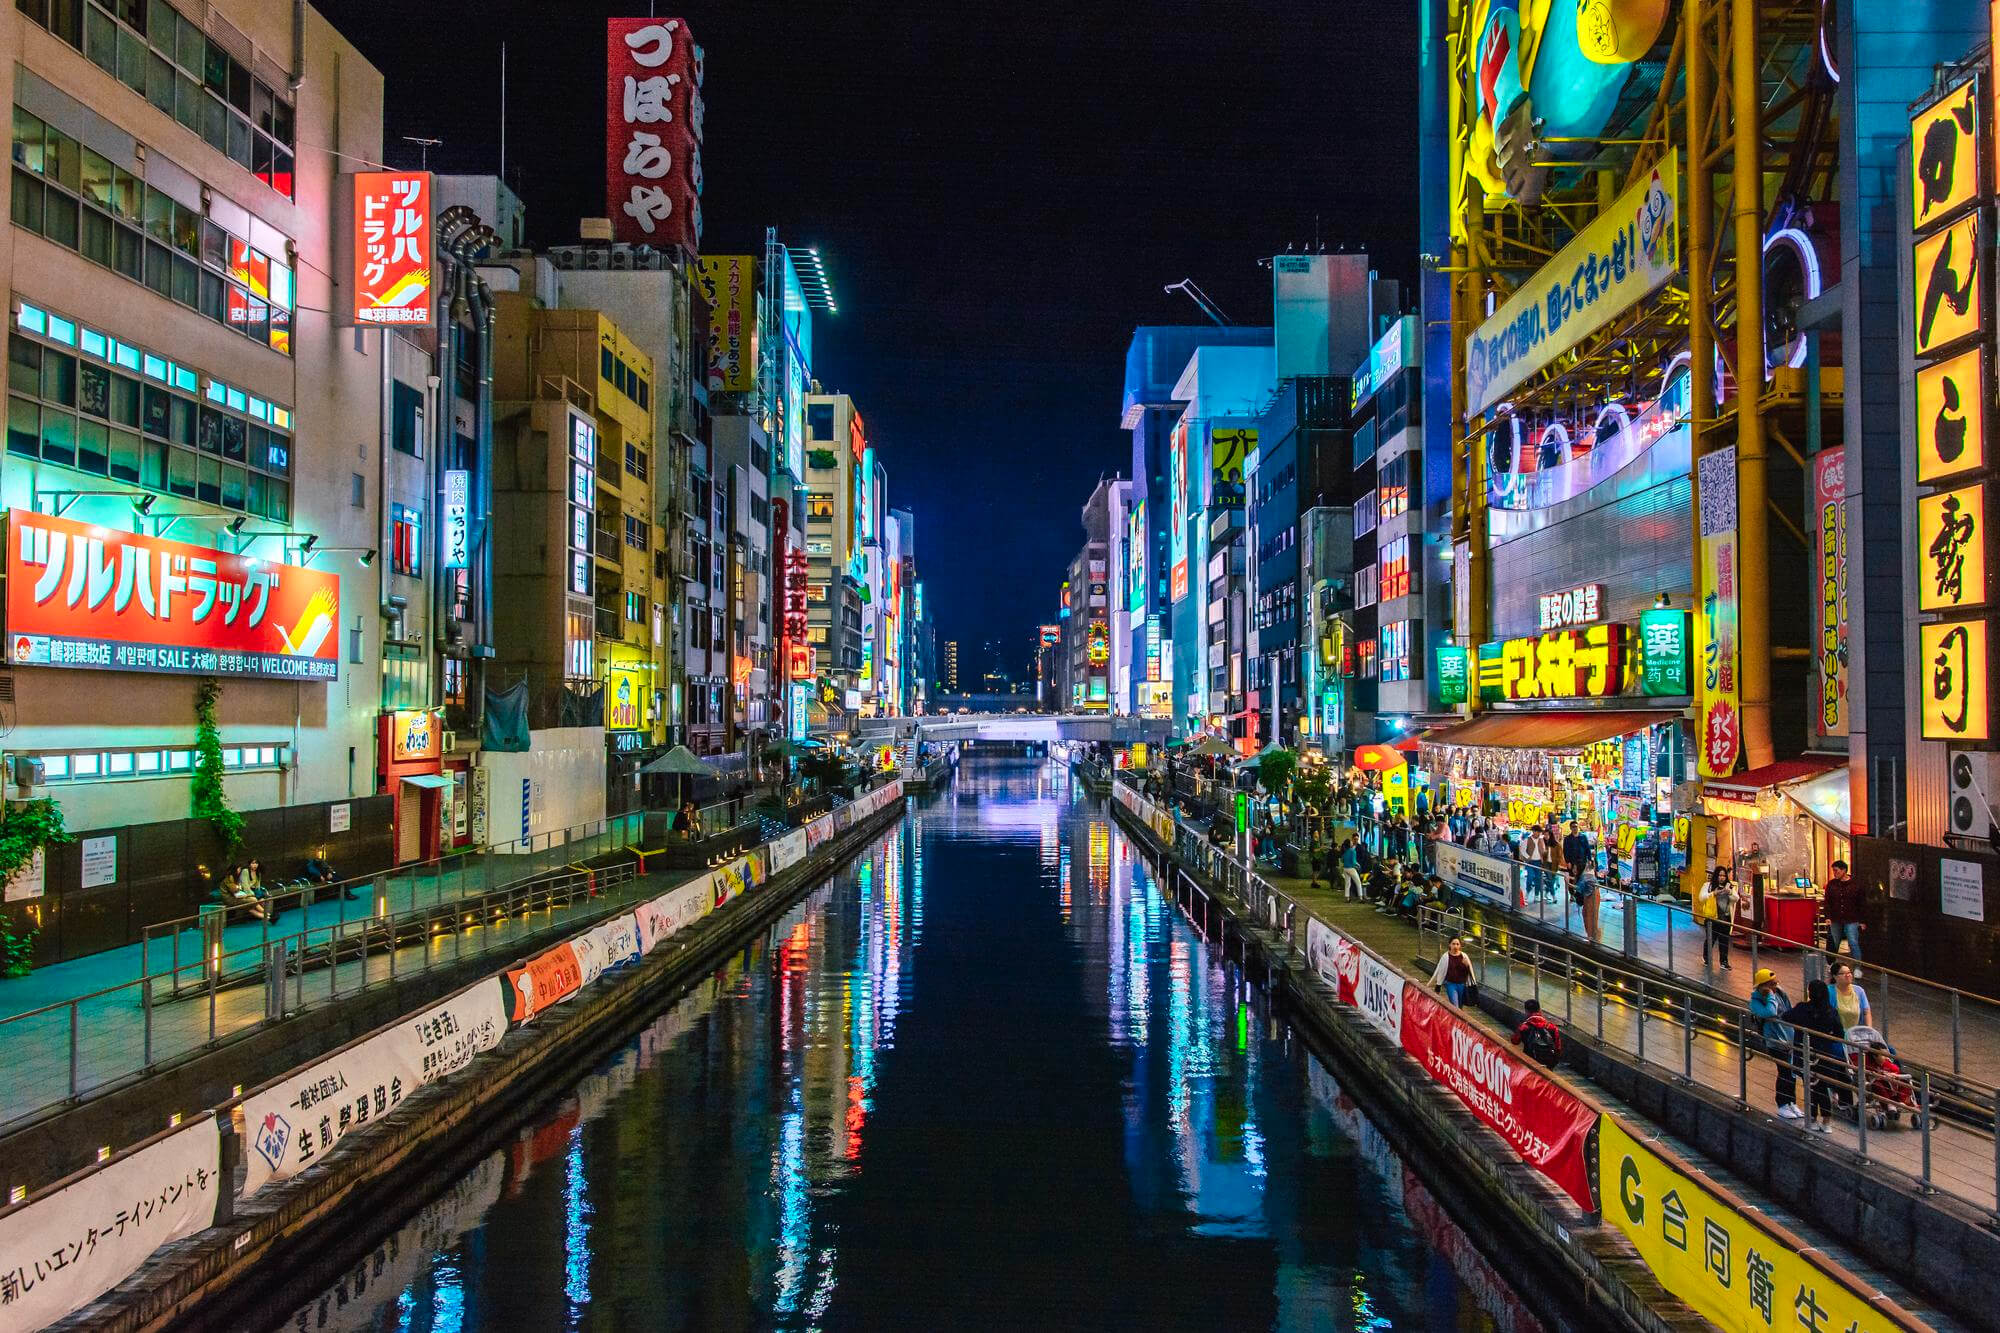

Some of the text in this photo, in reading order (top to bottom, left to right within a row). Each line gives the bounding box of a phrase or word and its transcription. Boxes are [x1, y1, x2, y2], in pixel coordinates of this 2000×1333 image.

[391, 180, 423, 264] ツルハ
[363, 195, 390, 286] ドラッグ
[20, 525, 280, 628] ツルハドラッグ
[1646, 622, 1681, 657] 薬
[115, 646, 157, 667] 세일판매
[158, 649, 189, 669] SALE
[220, 653, 259, 673] 환영합니다
[262, 657, 308, 676] WELCOME
[1441, 655, 1465, 678] 薬
[1666, 669, 1681, 683] 약
[1711, 712, 1733, 738] すぐ
[1711, 740, 1731, 765] そこ
[289, 1070, 349, 1111] 一般社団法人
